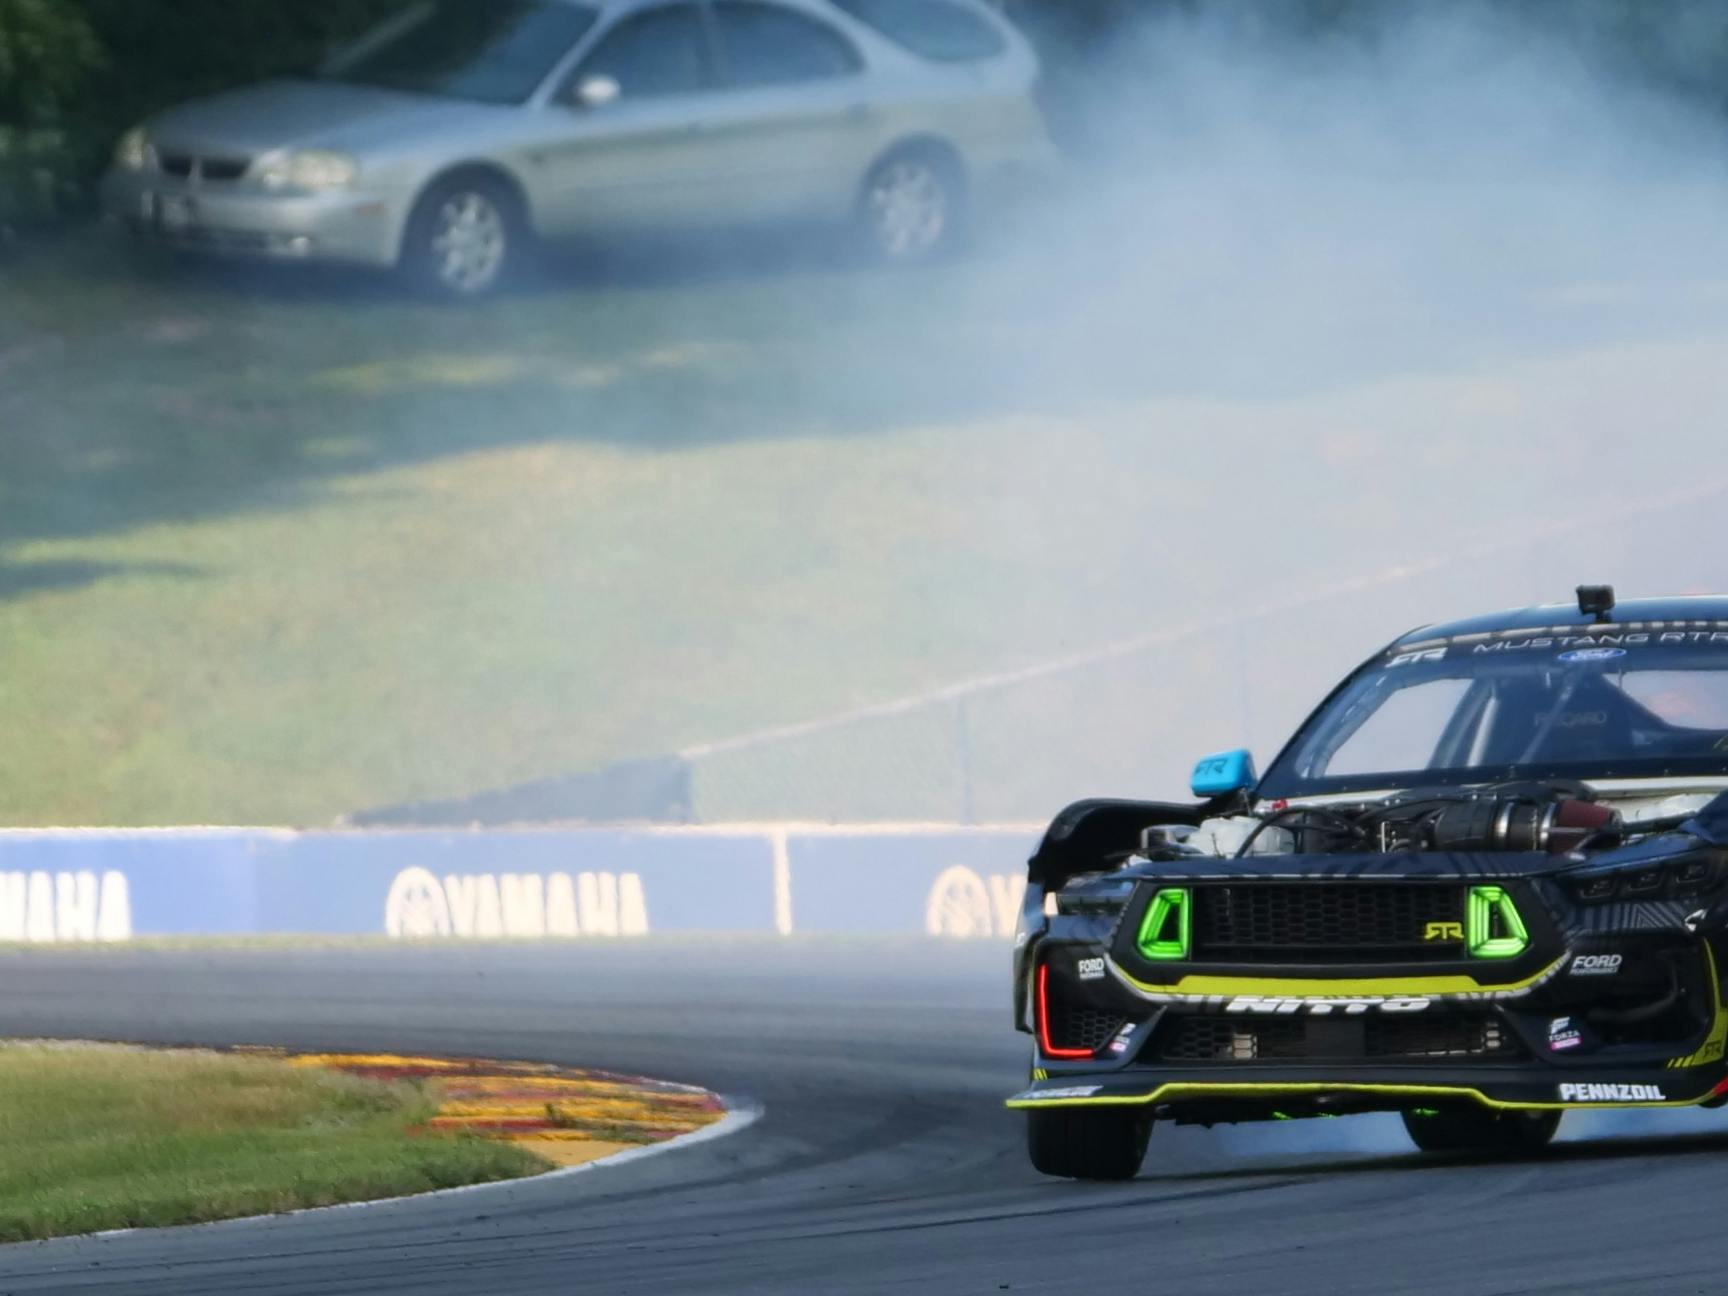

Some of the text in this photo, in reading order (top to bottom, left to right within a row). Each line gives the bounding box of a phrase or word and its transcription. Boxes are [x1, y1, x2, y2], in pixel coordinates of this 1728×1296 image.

[1474, 632, 1649, 653] MUSTANG
[443, 871, 648, 938] YAMAHA
[1078, 958, 1105, 974] FORD
[1572, 954, 1622, 969] FORD
[1226, 996, 1431, 1013] NITTO
[1559, 1083, 1666, 1100] PENNZOIL
